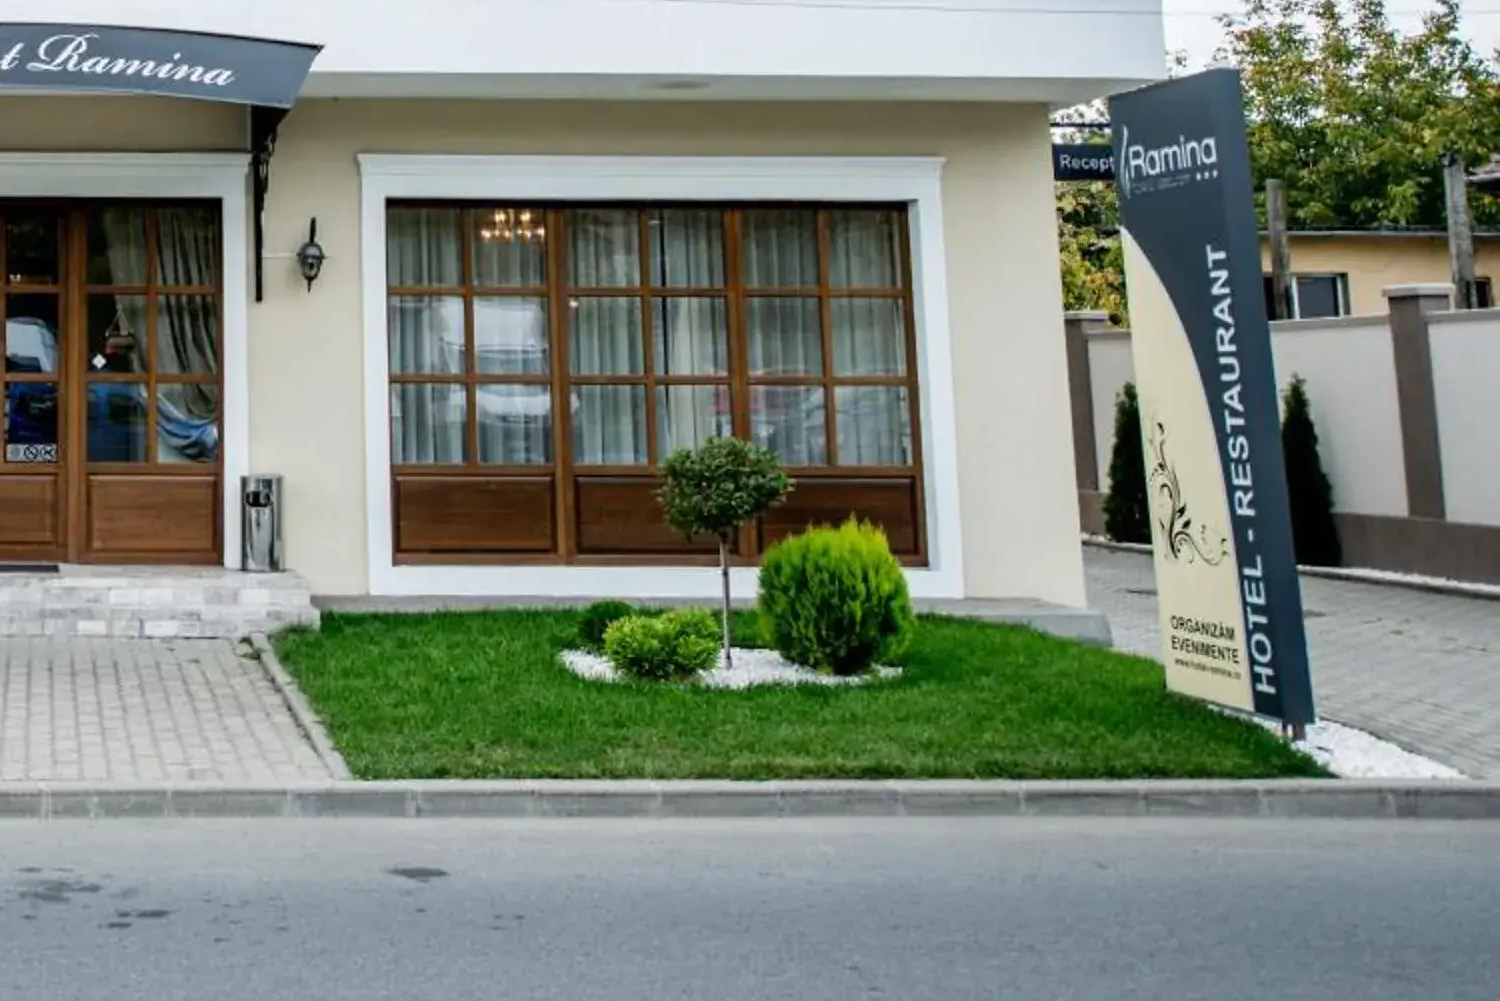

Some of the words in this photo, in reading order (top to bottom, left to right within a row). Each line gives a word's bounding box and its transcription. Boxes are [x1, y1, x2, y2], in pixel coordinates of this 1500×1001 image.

[25, 33, 236, 86] Ramina
[1128, 134, 1218, 179] Ramina
[1206, 244, 1256, 517] RESTAURANT
[1171, 635, 1240, 664] EVENIMENTE
[1242, 554, 1277, 694] HOTEL
